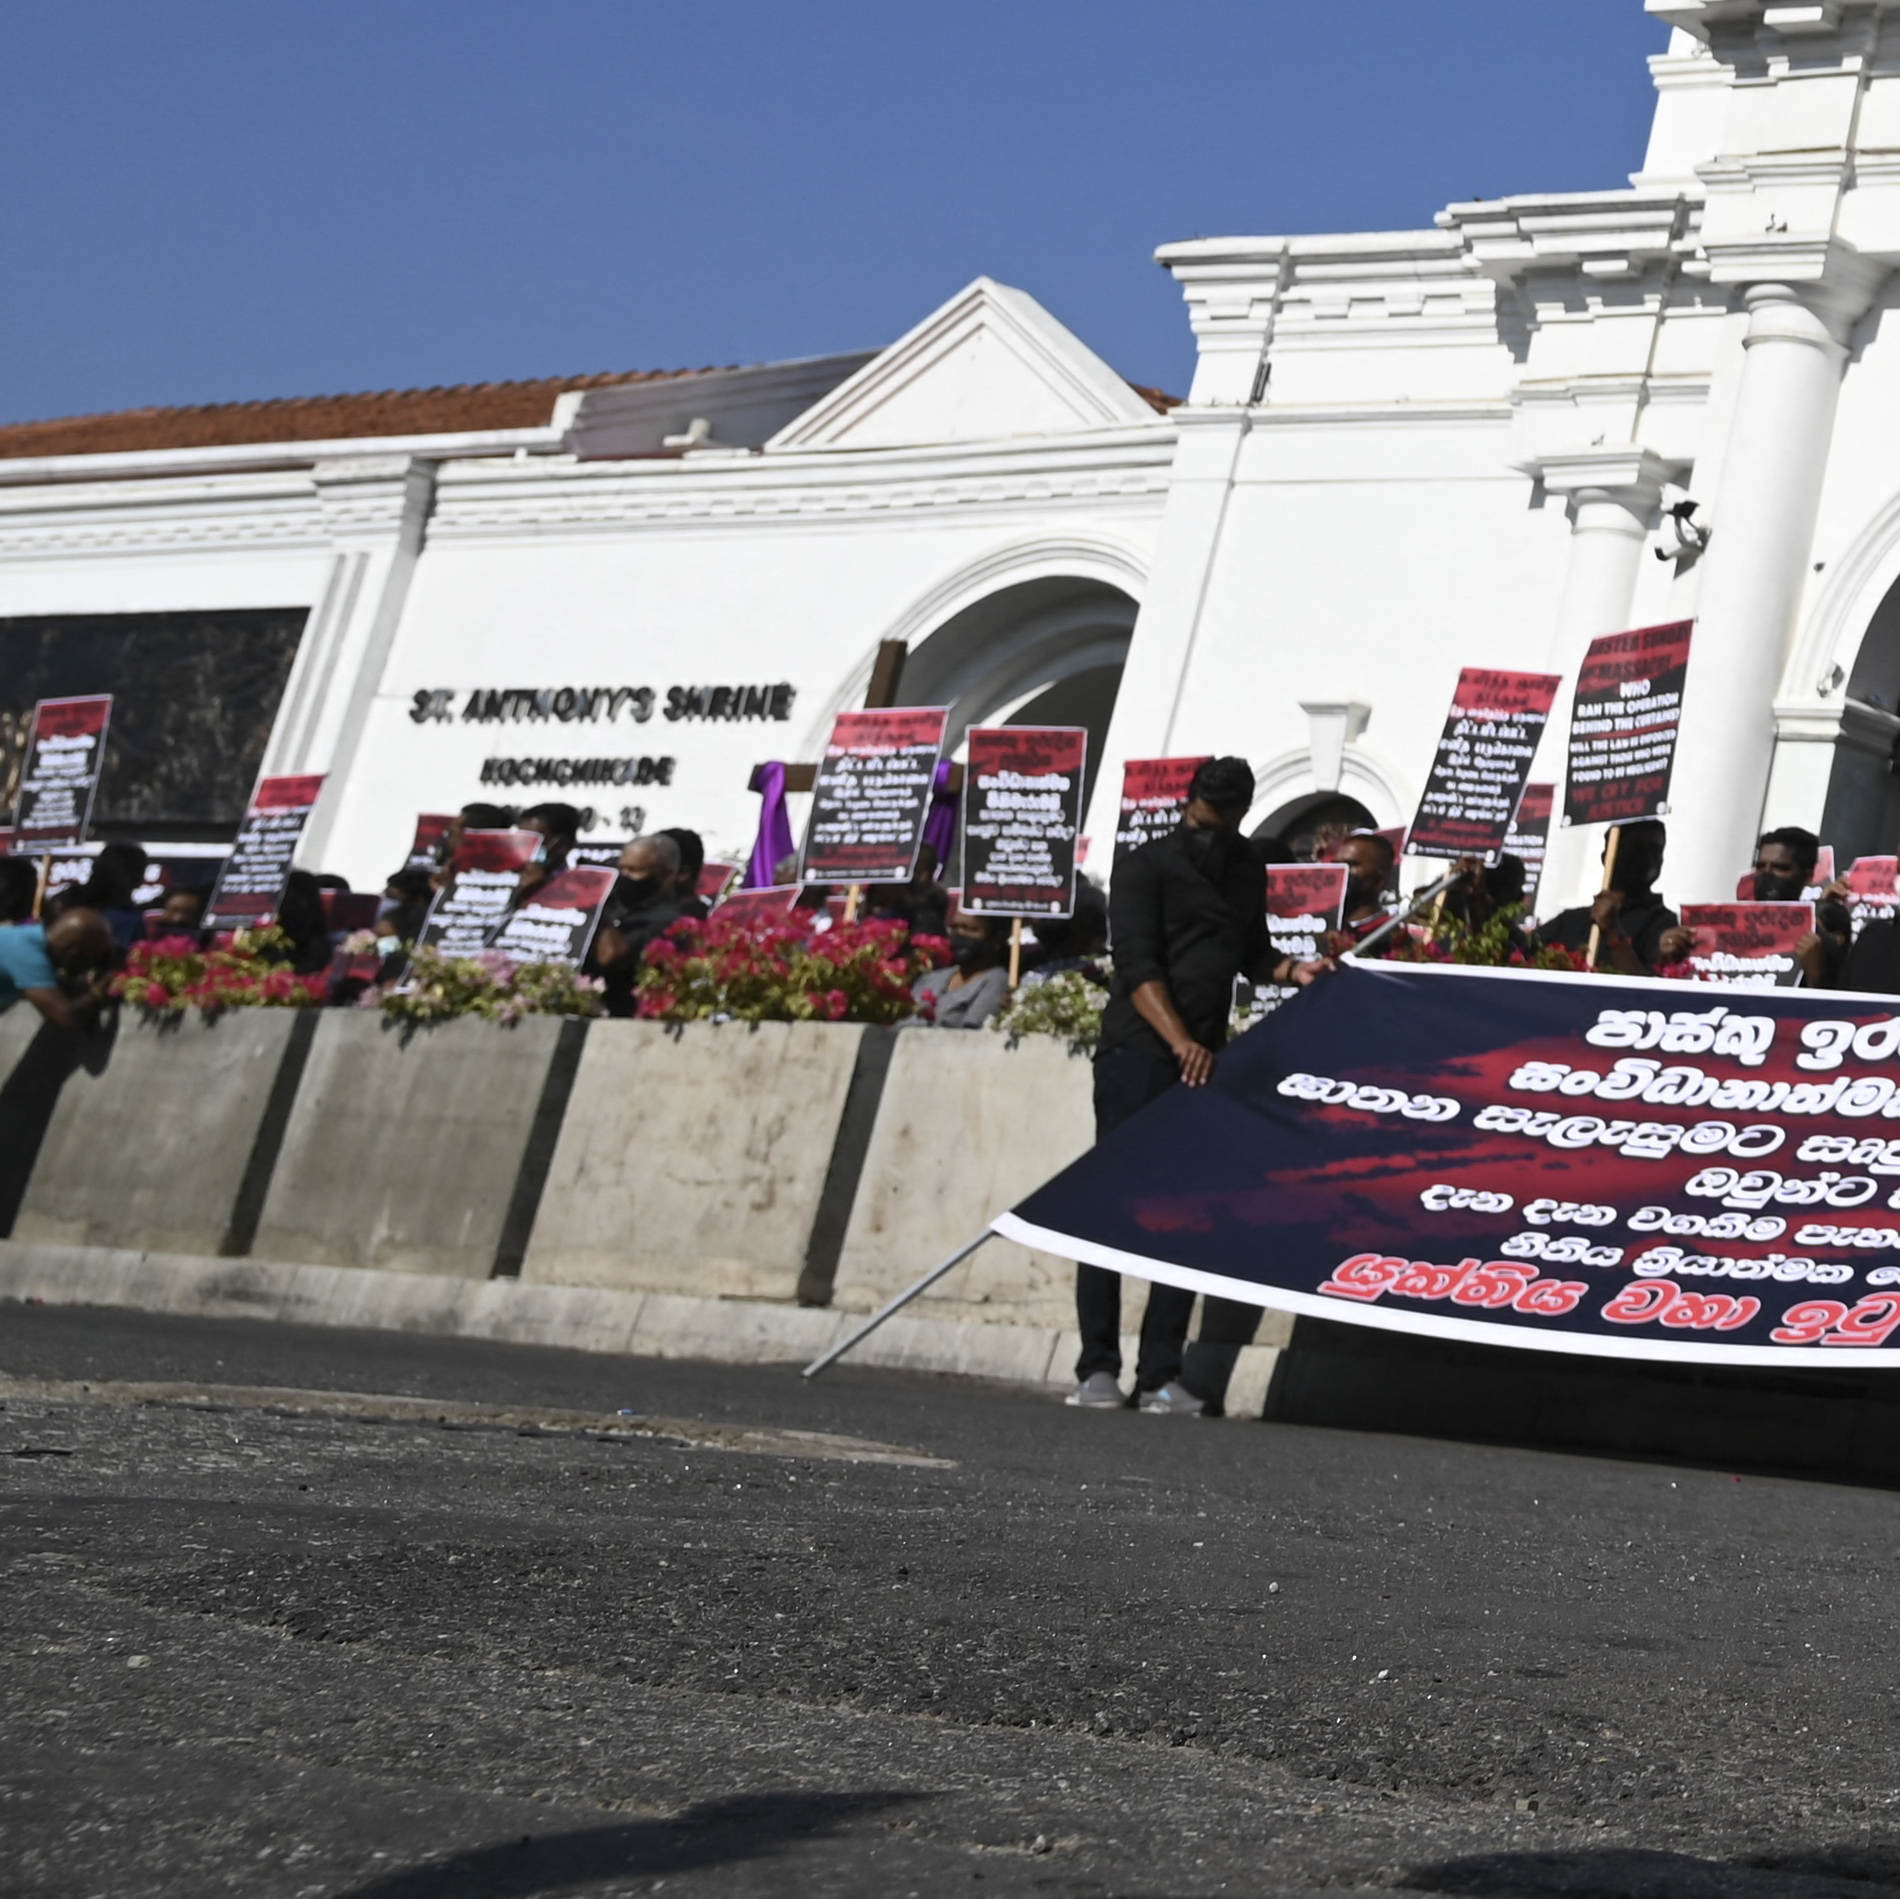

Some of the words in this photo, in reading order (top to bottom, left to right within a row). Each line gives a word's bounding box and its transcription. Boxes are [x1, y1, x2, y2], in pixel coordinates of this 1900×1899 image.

[460, 686, 657, 724] ANTHONY'S
[663, 681, 797, 724] SHRINE
[1577, 703, 1602, 718] RAN
[1604, 700, 1625, 716] THE
[1626, 692, 1679, 713] OPERATION
[1620, 679, 1651, 698] WHO
[1572, 719, 1613, 735] BEHIND
[1614, 716, 1634, 731] THE
[1586, 1006, 1776, 1066] පාස්කු
[1685, 1167, 1879, 1209] ඔවුන්ට
[1317, 1252, 1589, 1315] යුක්තිය
[1601, 1280, 1761, 1331] වහා
